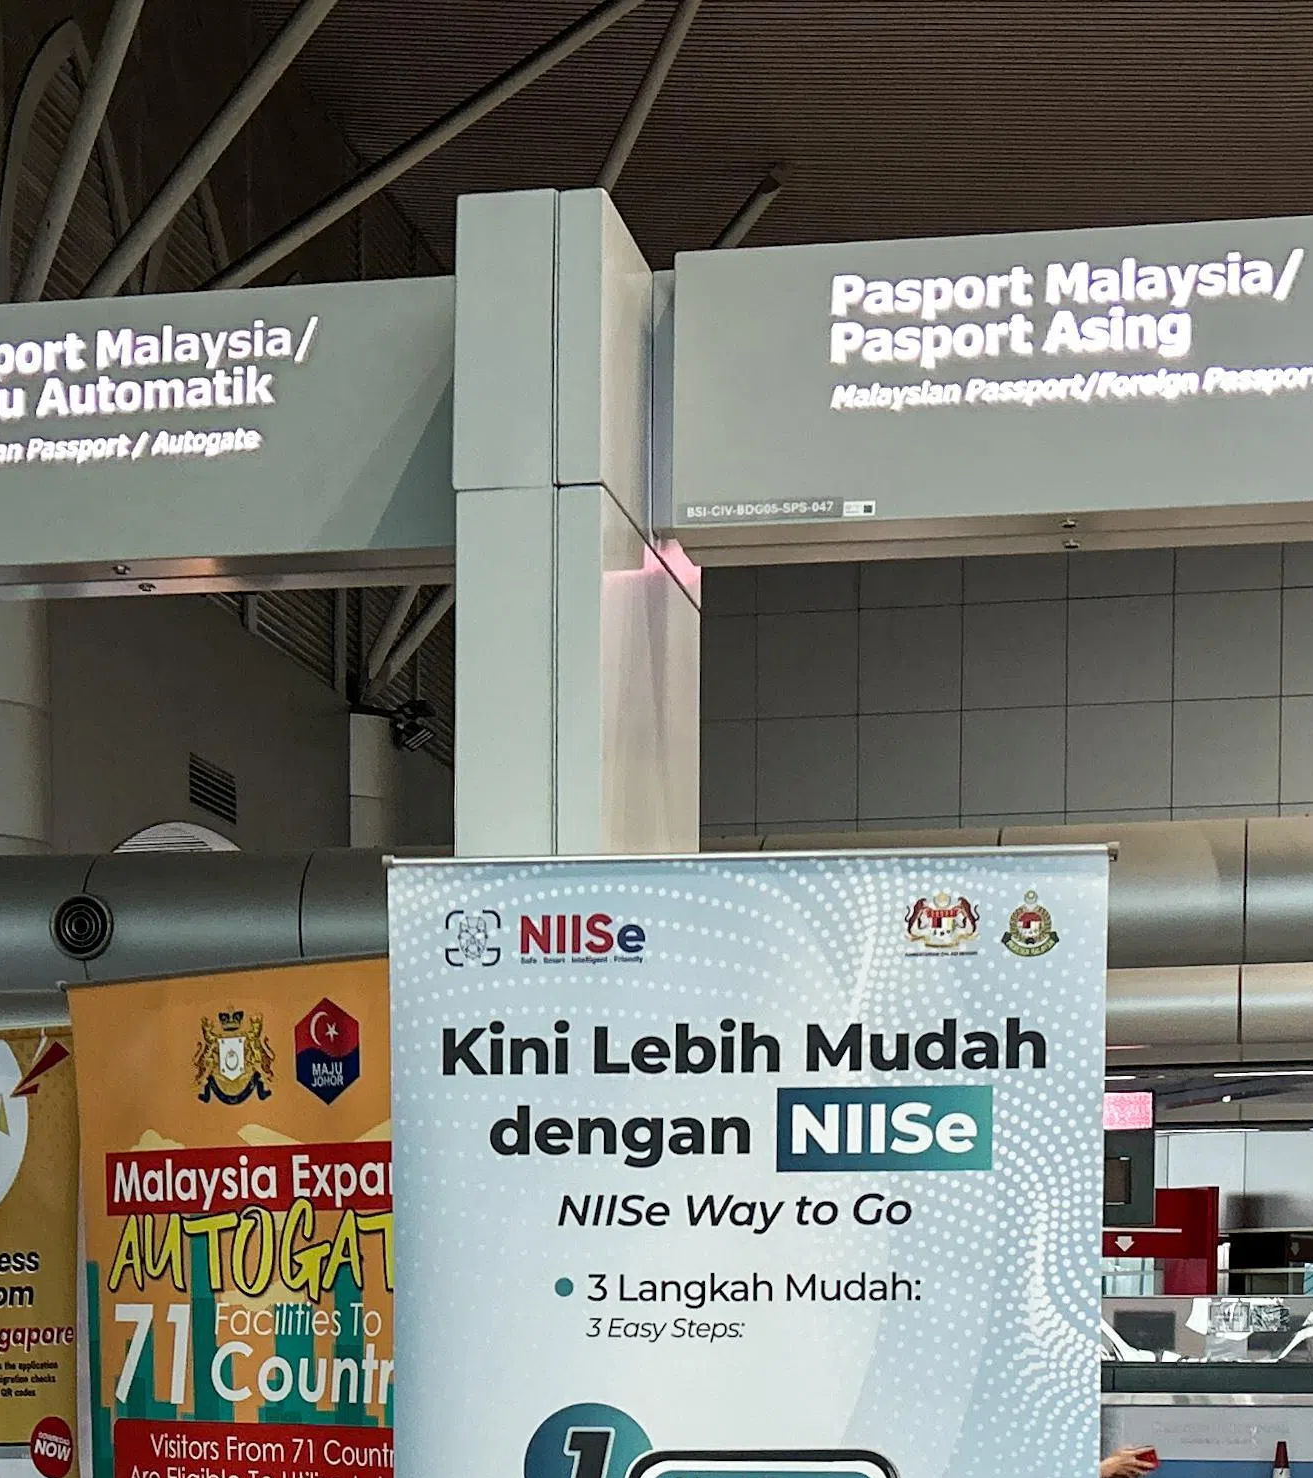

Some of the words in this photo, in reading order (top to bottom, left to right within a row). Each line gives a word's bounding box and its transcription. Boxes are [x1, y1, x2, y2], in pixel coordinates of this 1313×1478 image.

[830, 266, 1034, 321] Pasport
[1045, 248, 1305, 309] Malaysia/
[95, 315, 318, 370] Malaysia/
[830, 312, 1034, 369] Pasport
[1042, 305, 1193, 357] Asing
[35, 365, 276, 418] Automatik
[830, 379, 960, 412] Malaysian
[26, 432, 131, 465] Passport
[152, 426, 263, 458] Autogate
[520, 913, 646, 954] NIISe
[442, 1020, 570, 1076] Kini
[593, 1019, 781, 1074] Lebih
[806, 1017, 1047, 1071] Mudah
[311, 1074, 344, 1088] JOHOR
[312, 1061, 343, 1077] MAJU
[489, 1105, 751, 1168] dengan
[792, 1101, 979, 1155] NIISe
[114, 1155, 277, 1211] Malaysia
[291, 1154, 393, 1208] Expa
[557, 1194, 671, 1227] NIISe
[686, 1194, 784, 1234] Way
[796, 1196, 838, 1226] to
[852, 1193, 913, 1226] Go
[587, 1273, 608, 1302] 3
[618, 1273, 773, 1308] Langkah
[786, 1272, 922, 1302] Mudah:
[214, 1302, 341, 1337] Facilities
[350, 1302, 382, 1337] To
[114, 1303, 191, 1405] 71
[34, 1439, 71, 1461] NOW
[150, 1433, 219, 1461] Visitors
[226, 1435, 284, 1463] From
[292, 1438, 314, 1464] 71
